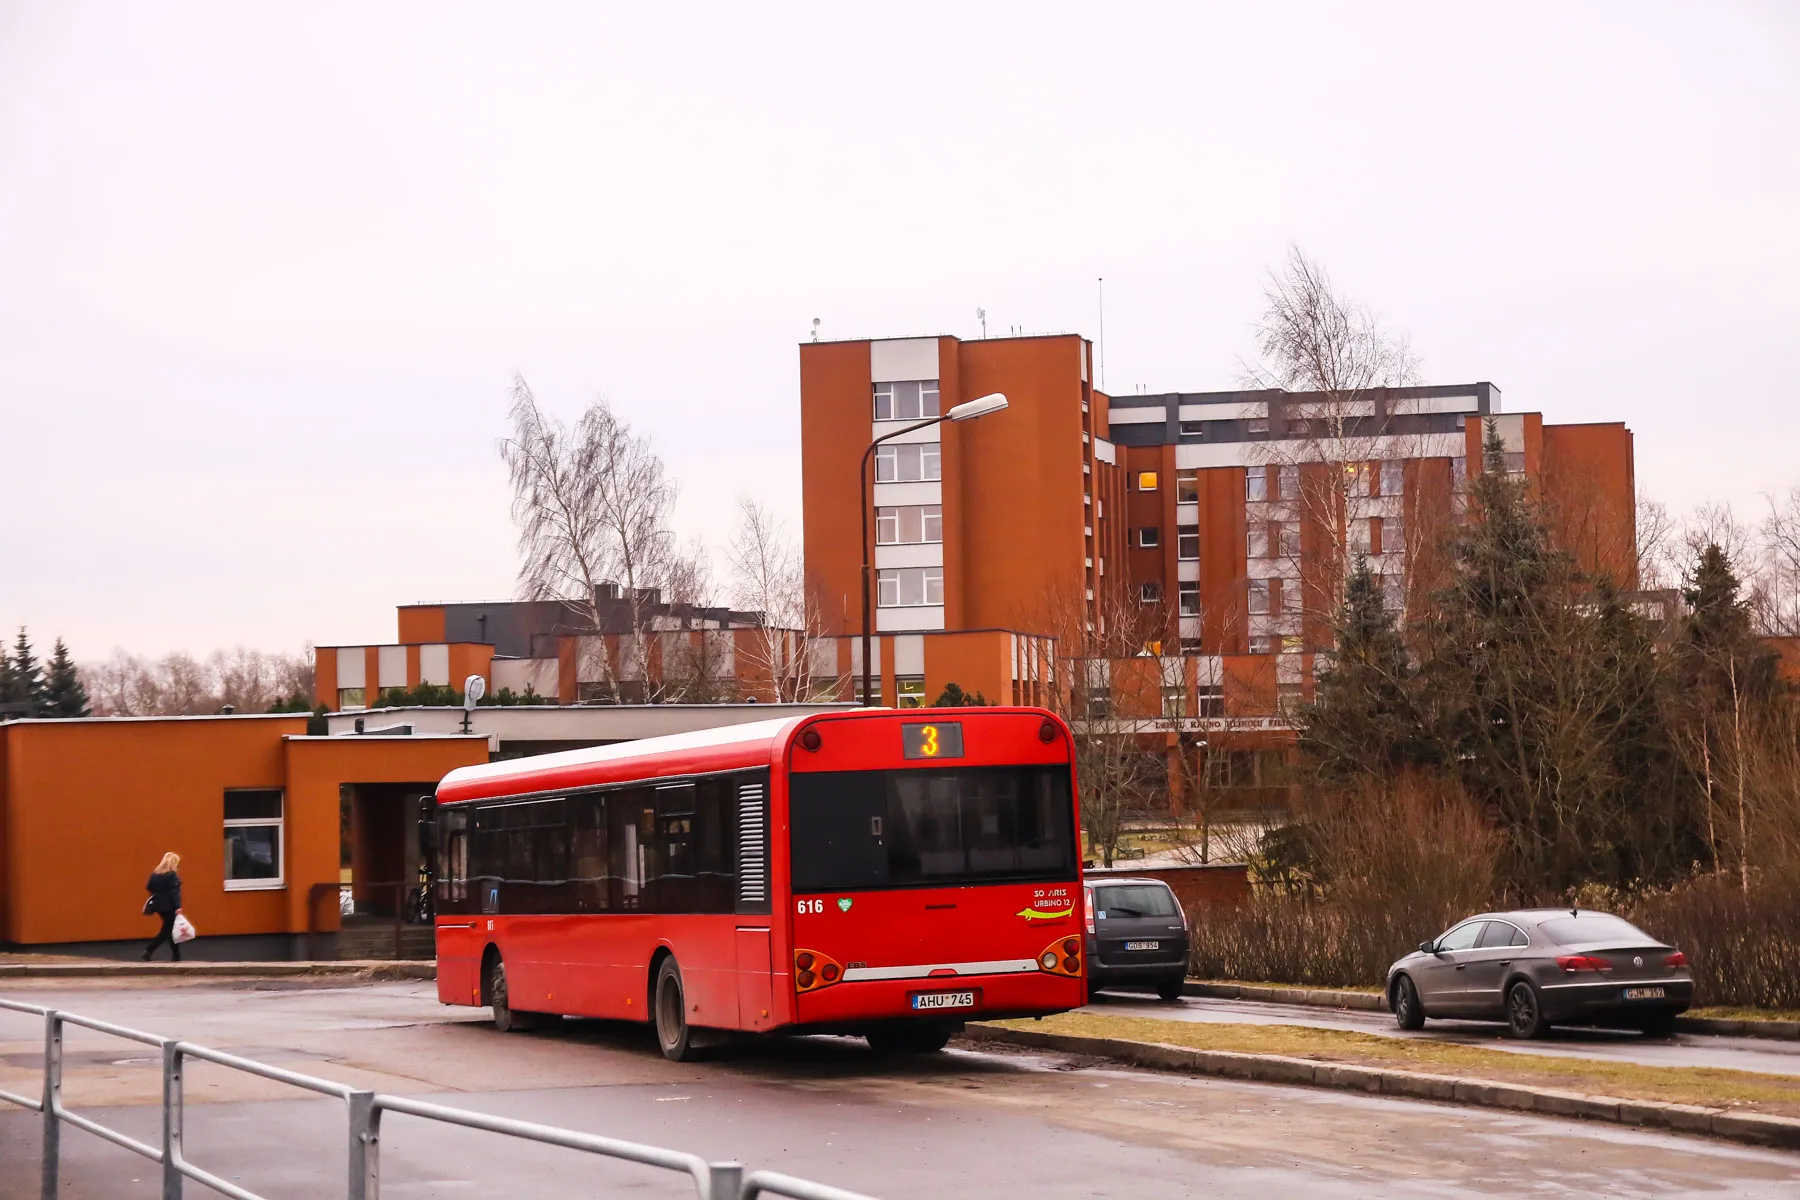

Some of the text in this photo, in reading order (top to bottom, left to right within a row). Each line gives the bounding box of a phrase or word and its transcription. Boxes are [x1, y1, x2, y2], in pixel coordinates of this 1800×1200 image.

[921, 725, 939, 757] 3
[797, 899, 824, 914] 616
[1034, 898, 1071, 908] URBINO 12
[919, 995, 944, 1007] AHU
[951, 993, 972, 1006] 745
